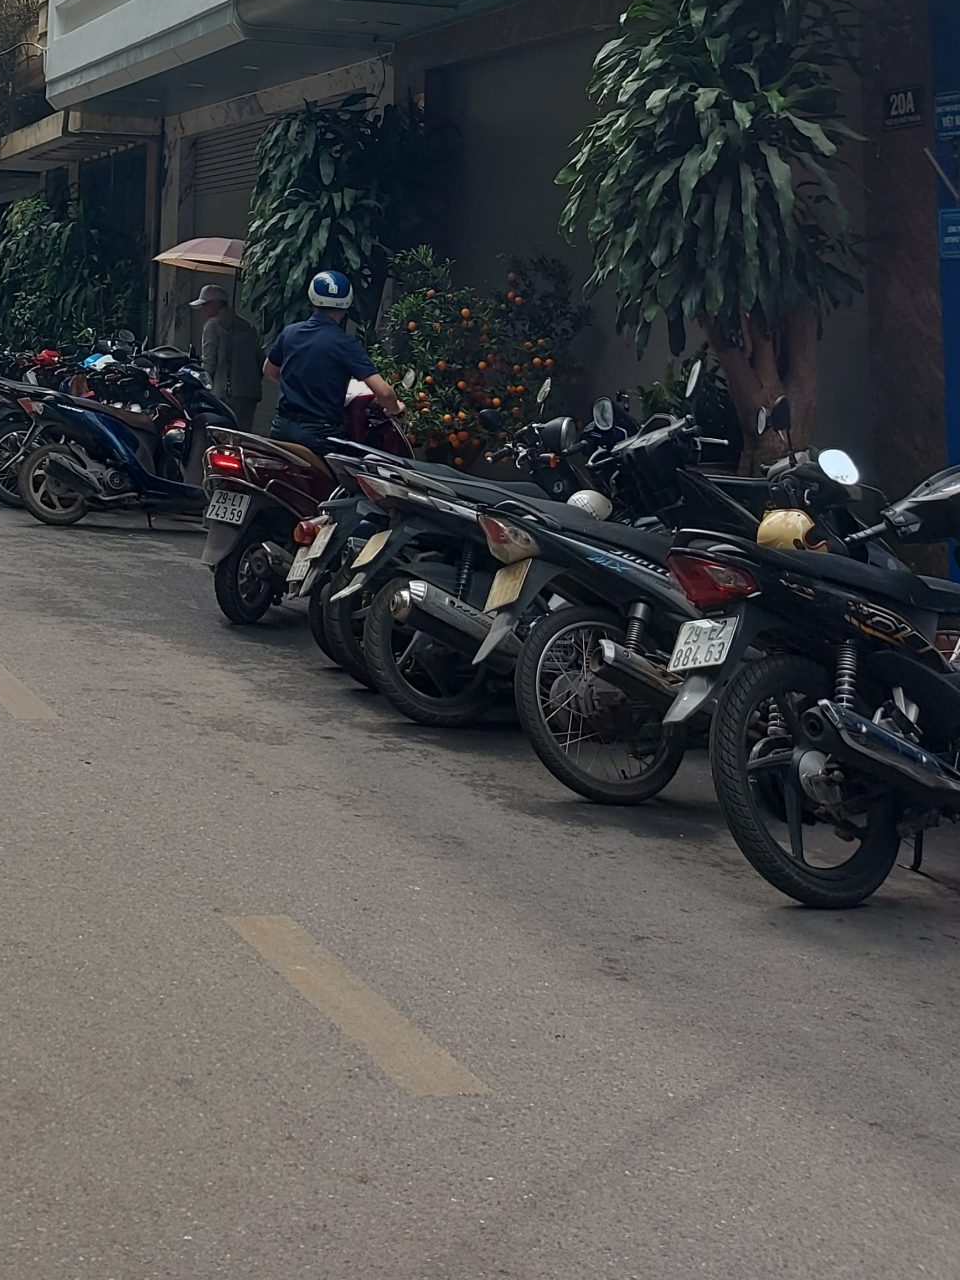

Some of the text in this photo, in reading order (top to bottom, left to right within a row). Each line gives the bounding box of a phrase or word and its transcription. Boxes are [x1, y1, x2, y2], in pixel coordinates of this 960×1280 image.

[890, 90, 916, 116] 20A
[215, 491, 244, 508] 29-L1
[208, 504, 243, 523] 743.59
[672, 641, 725, 669] 884.63
